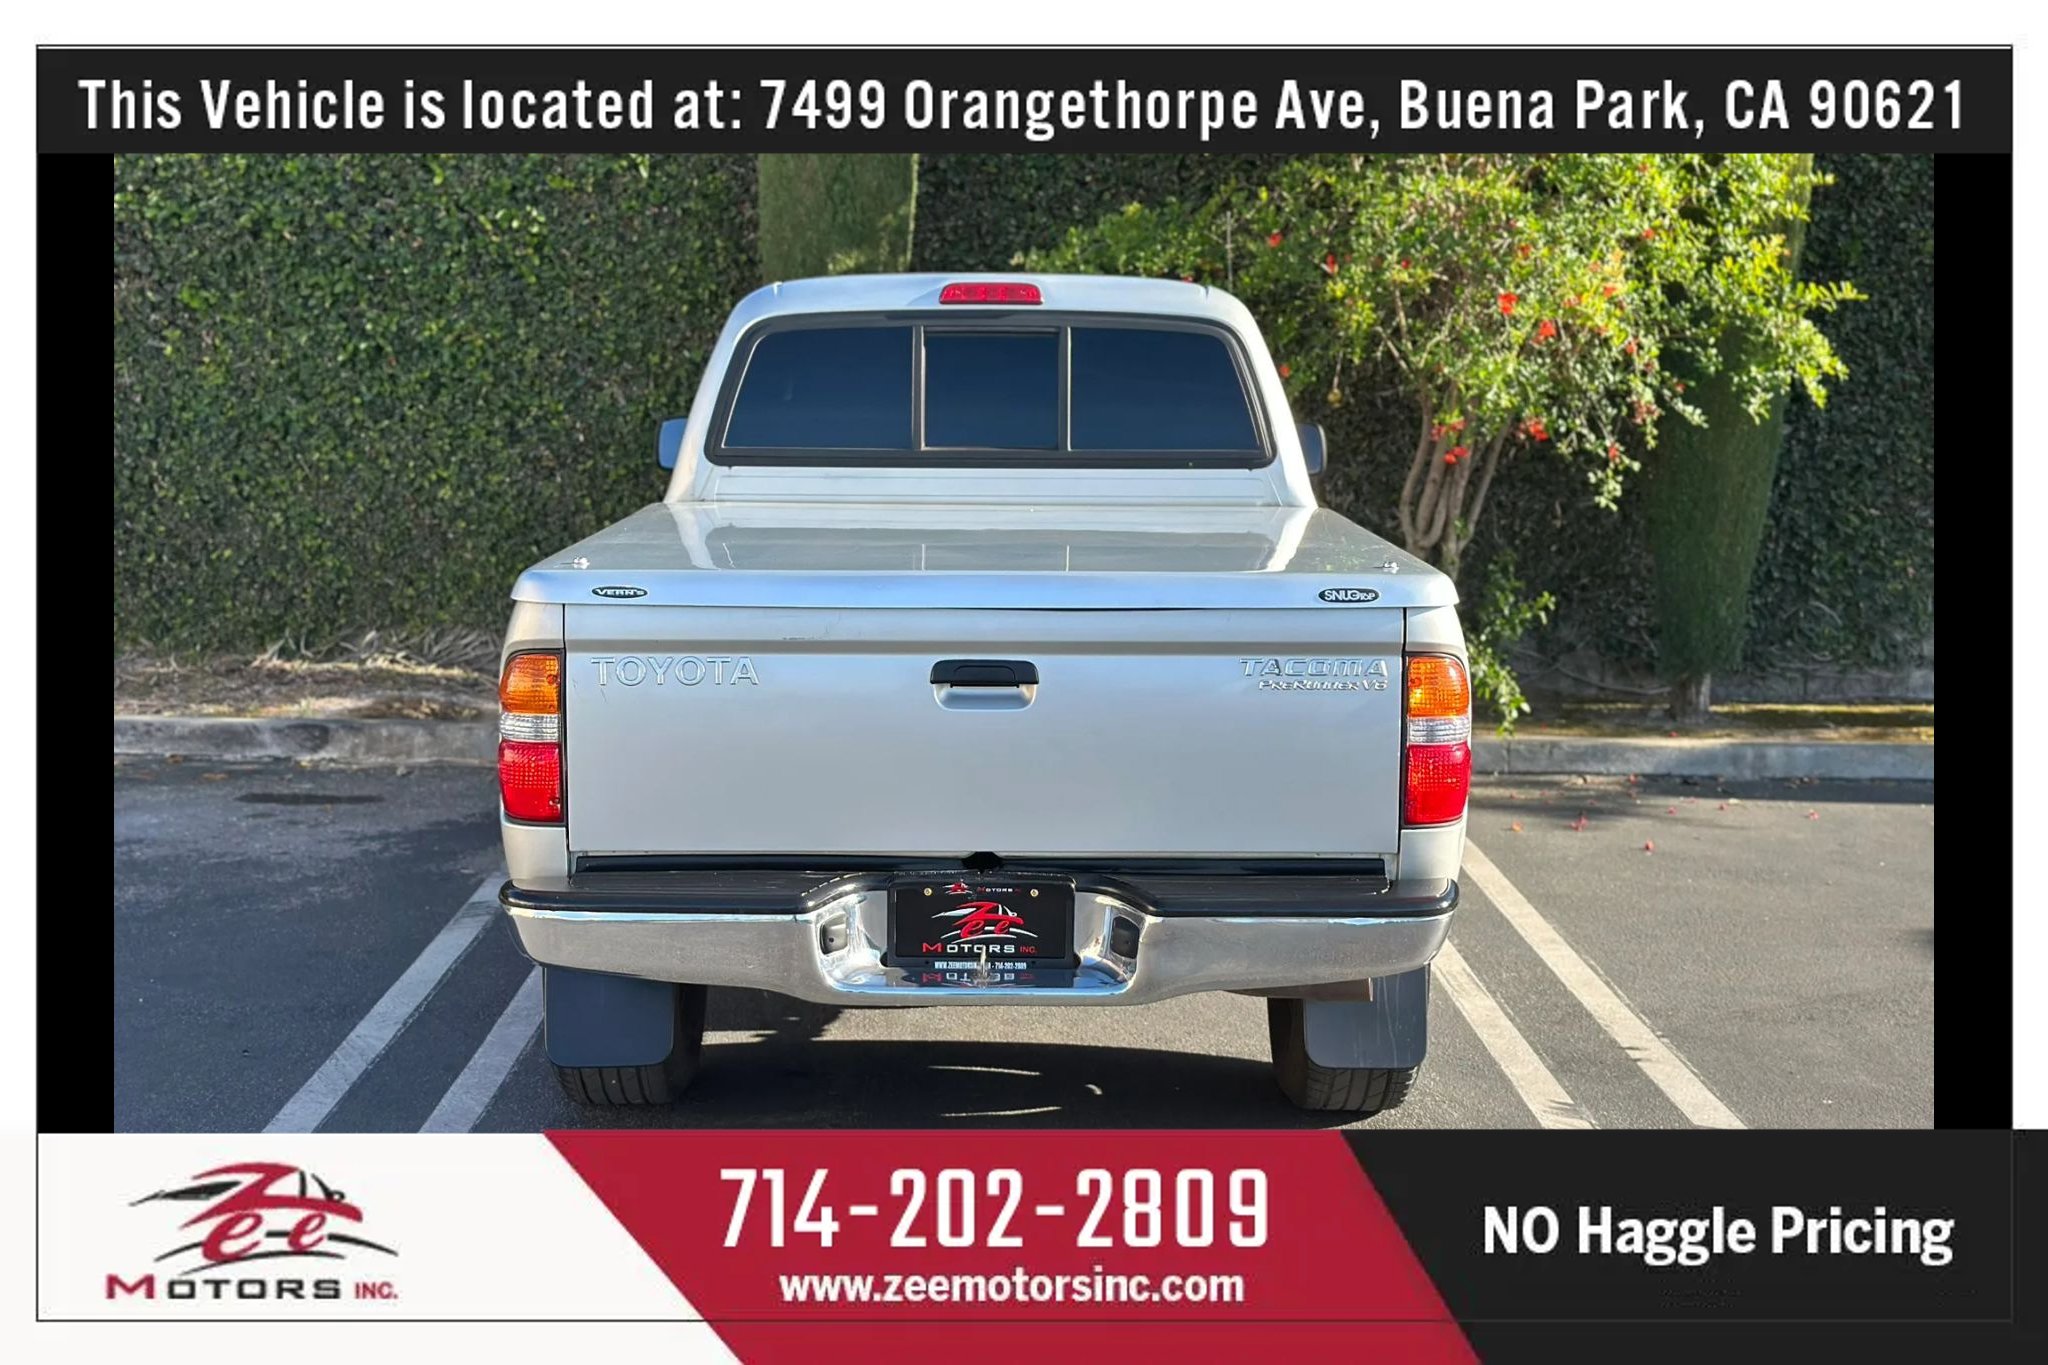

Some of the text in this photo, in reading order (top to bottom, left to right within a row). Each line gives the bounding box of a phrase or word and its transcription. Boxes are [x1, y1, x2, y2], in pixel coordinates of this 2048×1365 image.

[591, 656, 760, 687] TOYOTA
[1240, 658, 1388, 677] TACOMA
[1362, 680, 1388, 691] V6
[922, 942, 1015, 953] MOTORS
